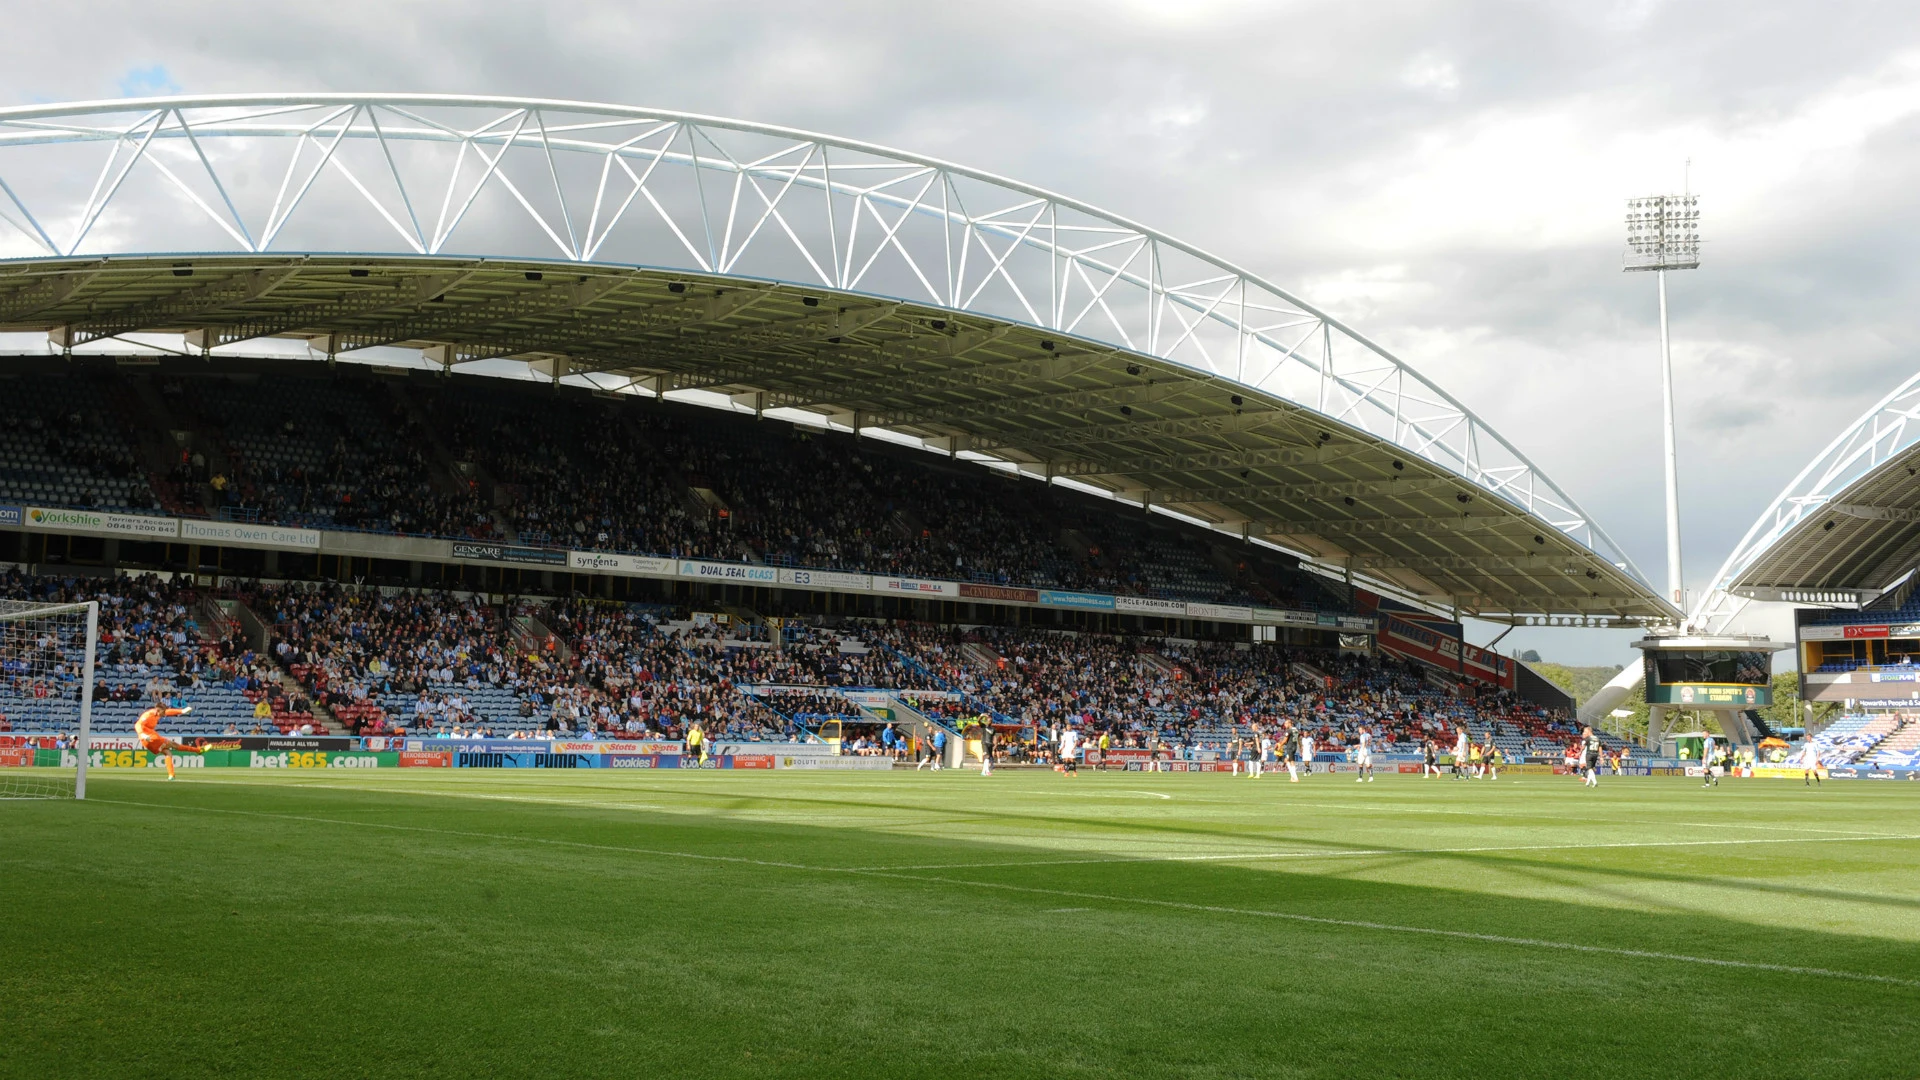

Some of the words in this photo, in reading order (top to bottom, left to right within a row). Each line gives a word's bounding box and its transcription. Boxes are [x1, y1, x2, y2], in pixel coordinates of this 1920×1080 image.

[41, 509, 101, 527] Yorkshire
[143, 519, 176, 527] Account
[106, 522, 132, 531] 0845
[158, 526, 176, 534] 845
[184, 523, 230, 537] Thomas
[234, 528, 267, 541] Owen
[271, 532, 297, 543] Care
[299, 532, 316, 545] Ltd
[454, 545, 501, 559] GENCARE
[577, 556, 619, 568] syngenta
[700, 565, 723, 576] DUAL
[725, 567, 745, 578] SEAL
[748, 568, 774, 580] GLASS
[794, 572, 811, 584] E3
[1116, 597, 1185, 609] CIRCLE-FASHION.COM
[1388, 618, 1442, 648] DIRECT
[1439, 637, 1478, 660] GOLF
[1880, 674, 1914, 682] STOREPLAN
[1697, 687, 1708, 695] THE
[1709, 694, 1733, 702] STADIUM
[1888, 699, 1908, 708] People
[75, 740, 133, 750] uarries
[375, 739, 382, 748] 7
[565, 742, 595, 751] Stotts
[609, 743, 638, 752] Stotts
[250, 750, 378, 768] bet365.com
[402, 752, 441, 760] REKORDERLIG
[459, 753, 503, 768] PUMA
[535, 753, 577, 768] PUMA
[613, 757, 651, 768] bookies
[1130, 762, 1142, 772] sky
[1160, 762, 1171, 772] sky
[1173, 763, 1187, 771] BET
[1189, 763, 1201, 772] sky
